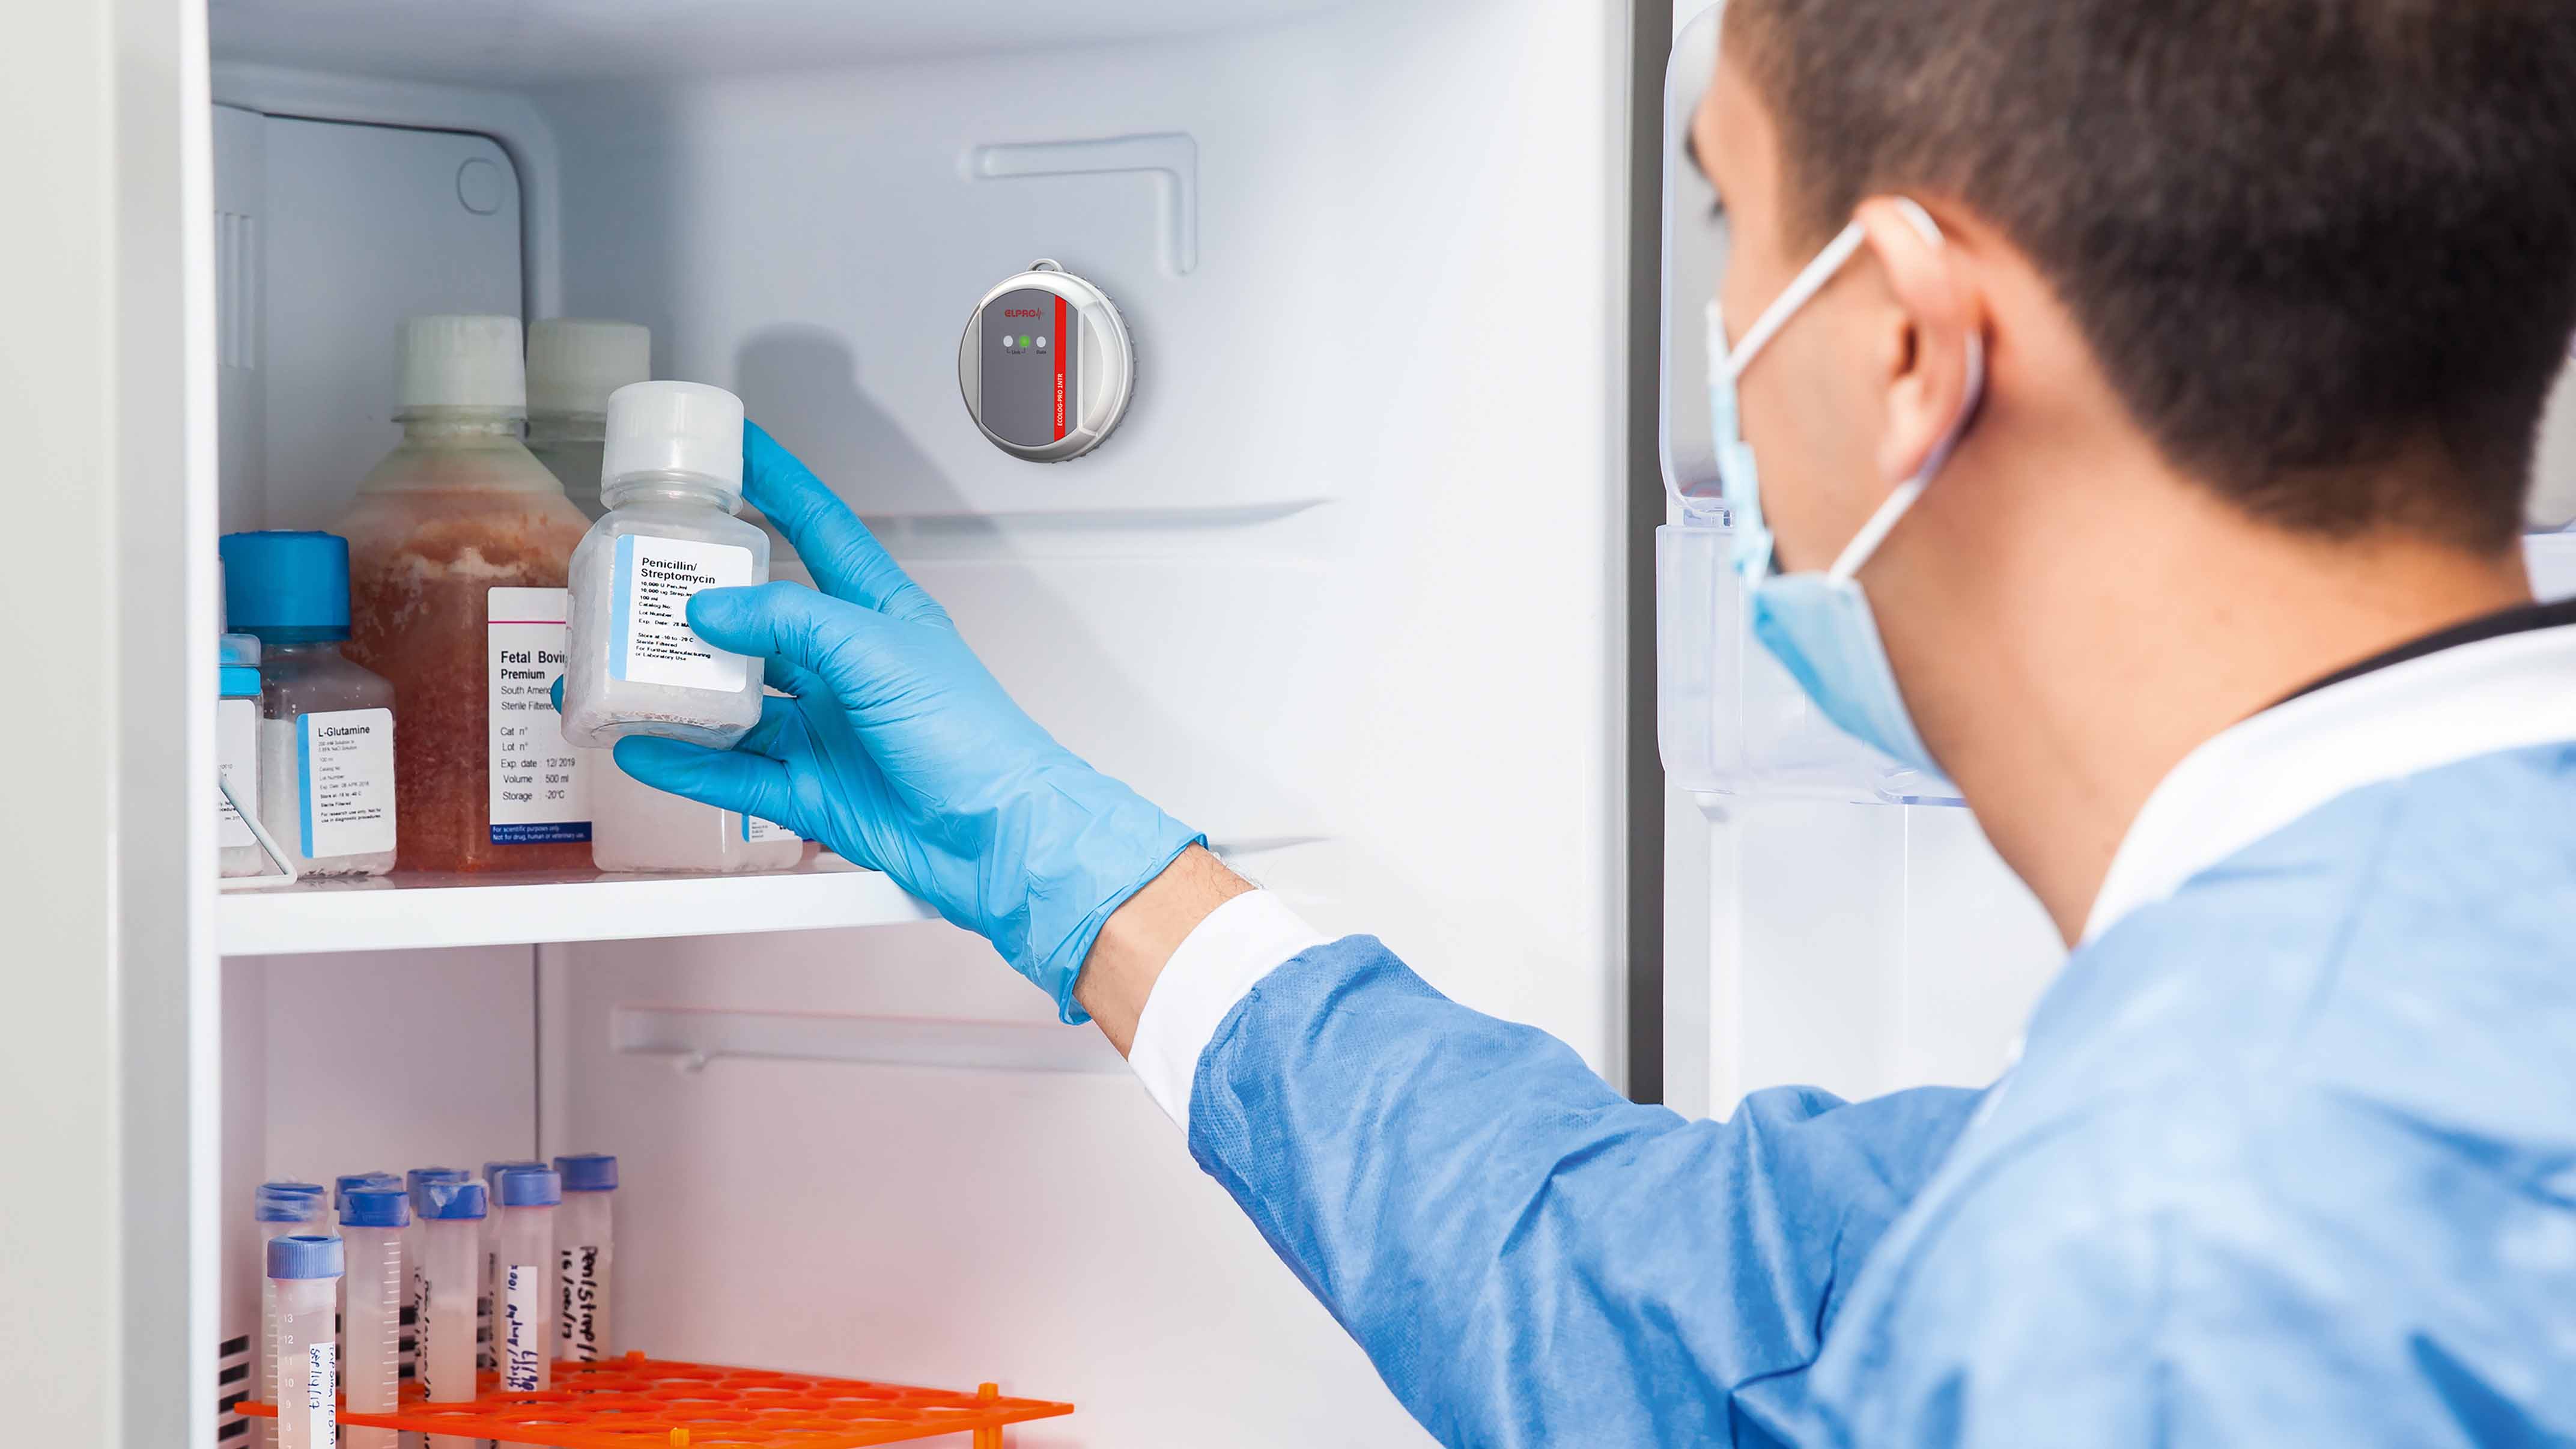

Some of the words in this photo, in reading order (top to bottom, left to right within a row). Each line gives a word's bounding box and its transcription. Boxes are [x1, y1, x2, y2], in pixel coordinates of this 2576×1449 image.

[642, 557, 697, 571] Penicillin/
[641, 568, 715, 584] Streptomycin
[500, 651, 530, 663] Fetal
[669, 649, 711, 659] Manufacturing
[500, 668, 545, 679] Premium
[500, 685, 524, 694] South
[501, 701, 527, 710] Sterile
[318, 724, 370, 737] L-Glutamine
[500, 726, 514, 736] Cat
[502, 742, 514, 751] Lot
[520, 759, 537, 768] date
[503, 774, 533, 783] Volume
[545, 774, 559, 783] 500
[560, 774, 569, 783] ml
[502, 791, 533, 802] Storage
[283, 1335, 294, 1344] 12
[284, 1378, 294, 1388] 10
